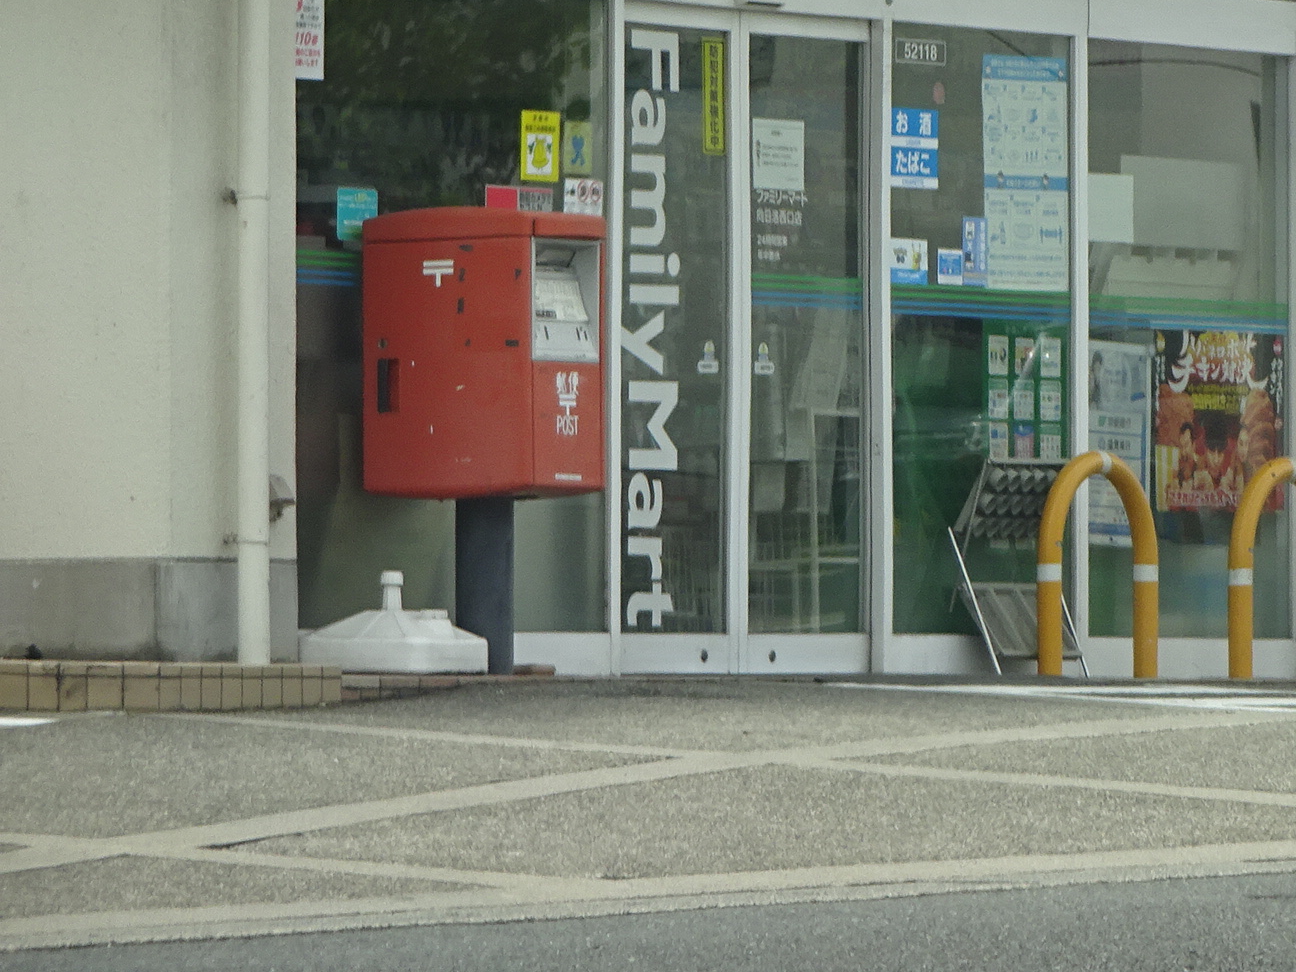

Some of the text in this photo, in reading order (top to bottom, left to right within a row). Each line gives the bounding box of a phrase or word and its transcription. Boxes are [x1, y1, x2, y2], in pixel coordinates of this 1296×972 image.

[904, 43, 938, 62] 52118
[896, 149, 931, 175] たばこ
[621, 29, 681, 627] FamilyMart
[556, 371, 579, 395] 郵便
[556, 416, 579, 436] POST
